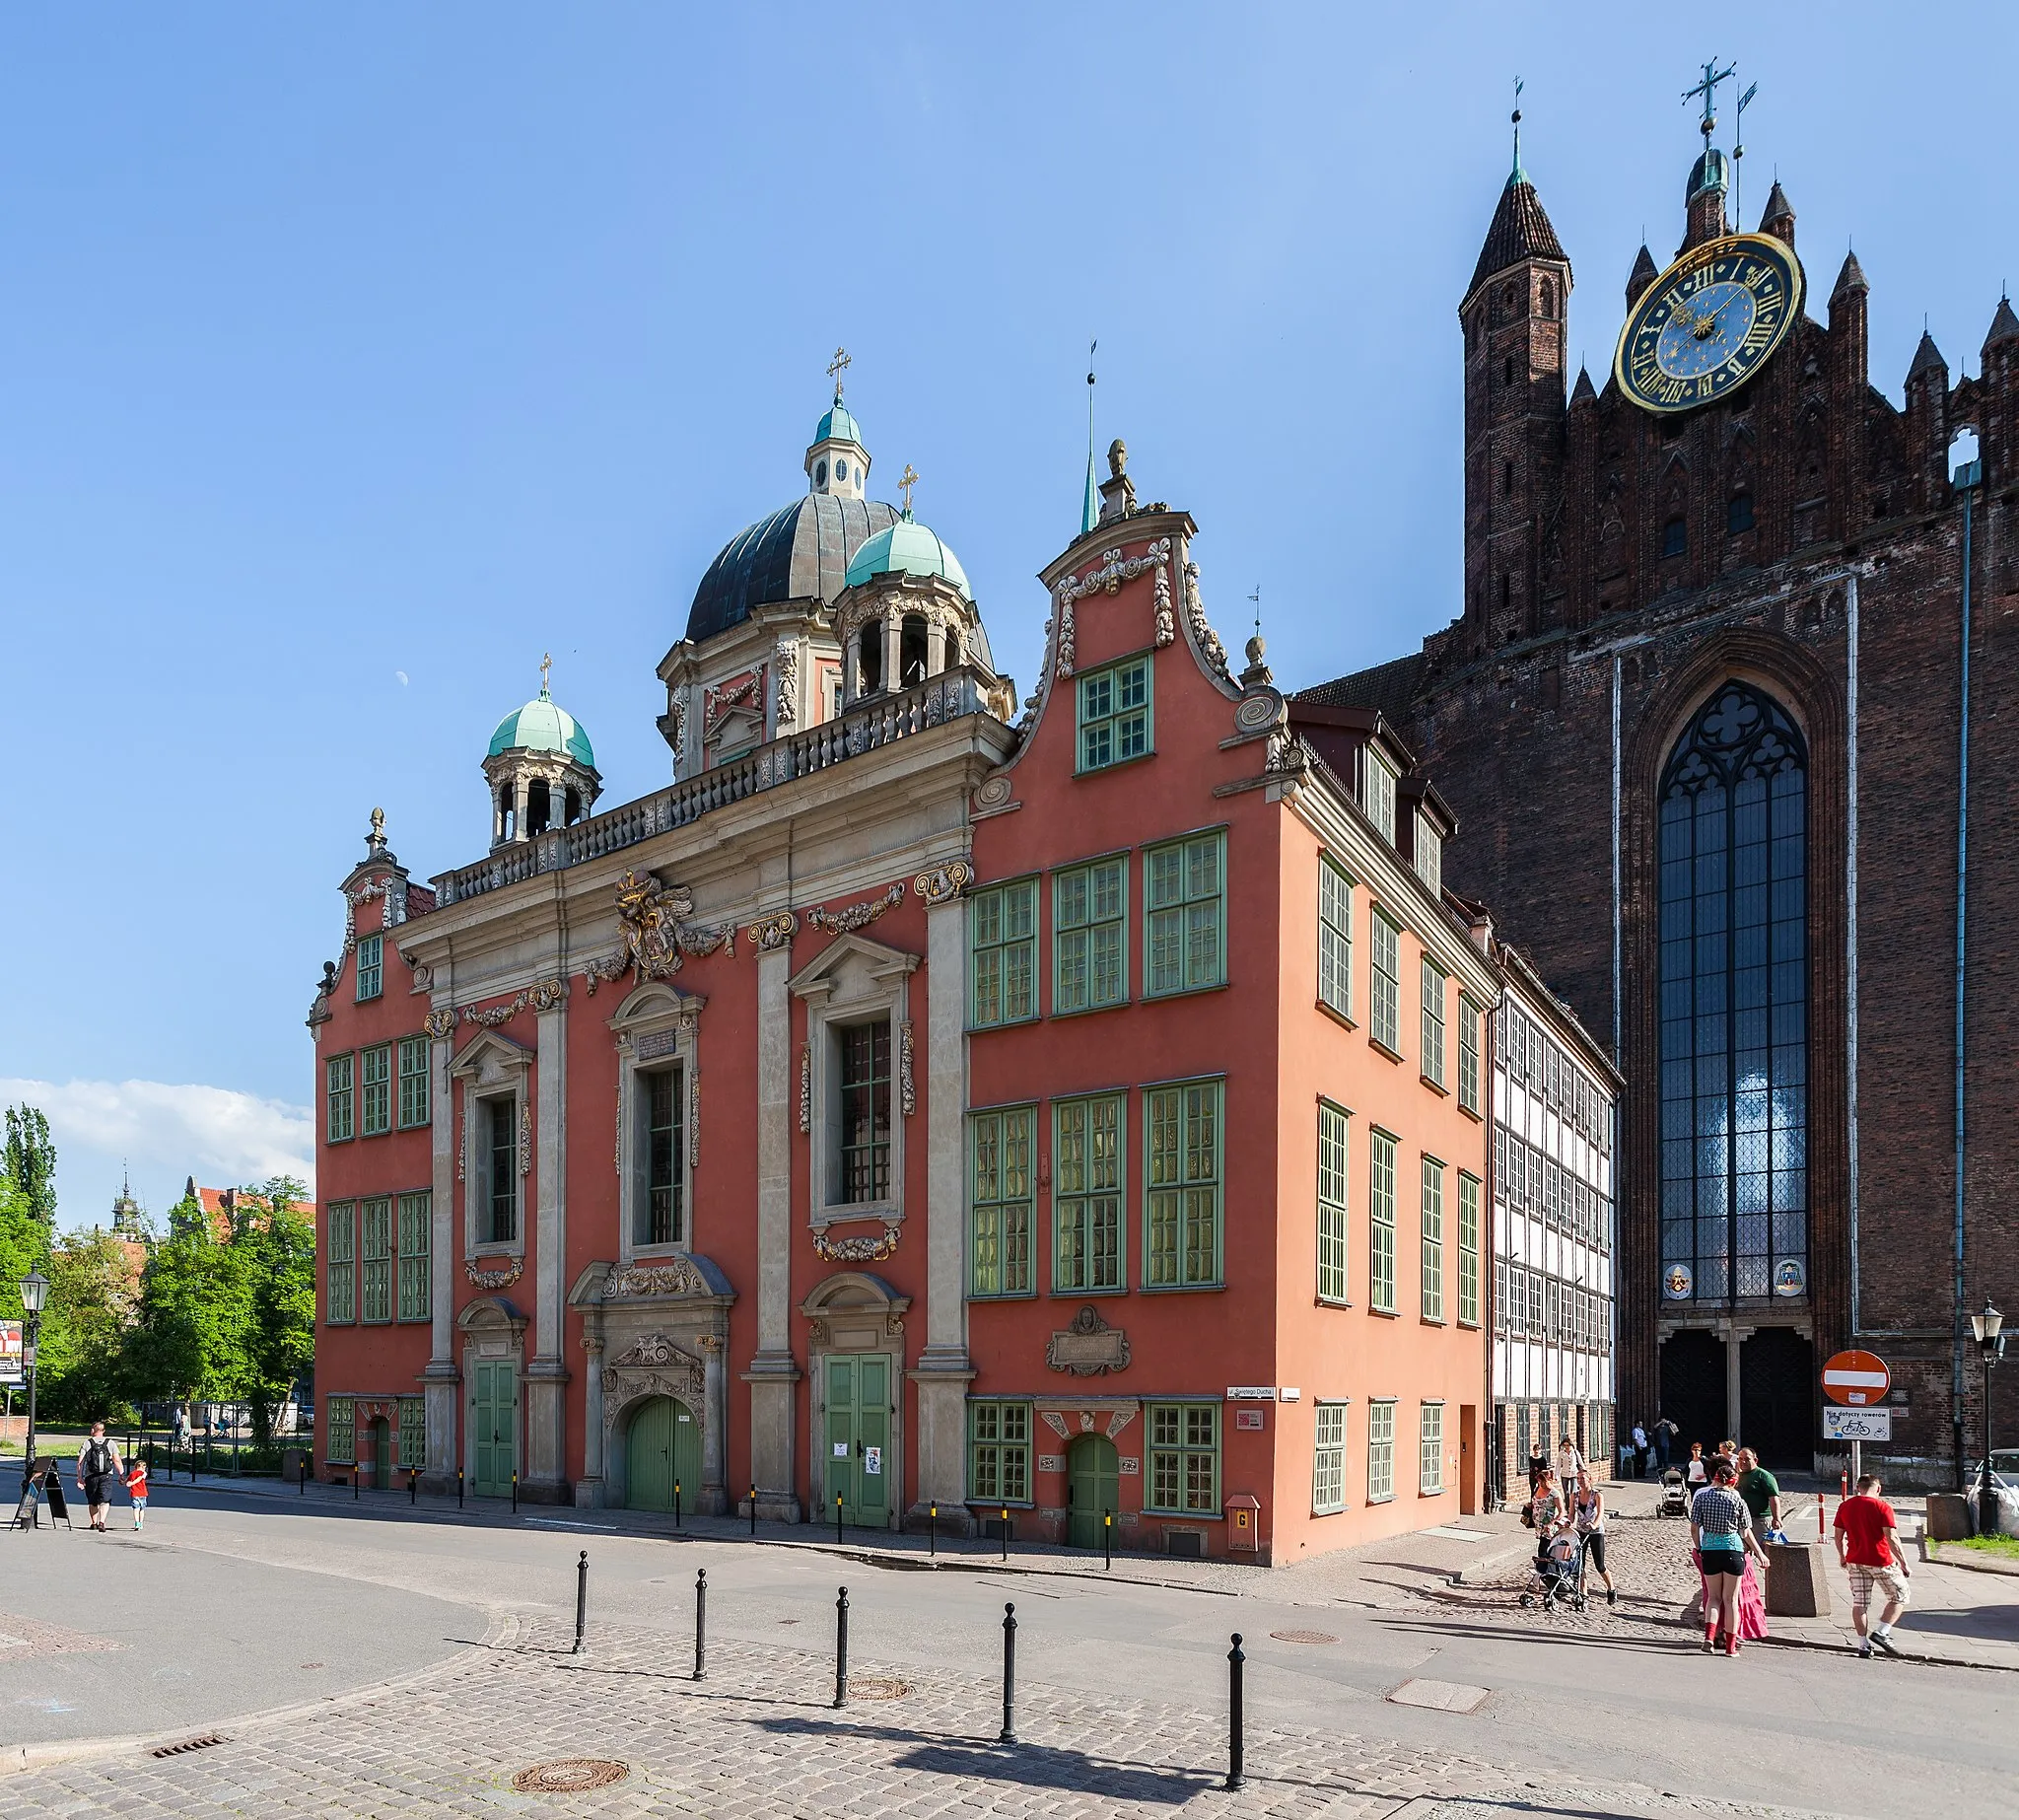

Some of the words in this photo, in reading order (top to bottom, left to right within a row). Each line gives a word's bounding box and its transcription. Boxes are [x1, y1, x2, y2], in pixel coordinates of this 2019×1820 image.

[1693, 262, 1715, 292] XII
[1729, 257, 1744, 281] I
[1756, 290, 1782, 316] III
[1639, 324, 1663, 335] X
[1744, 322, 1775, 349] IIII
[1238, 1513, 1247, 1526] G
